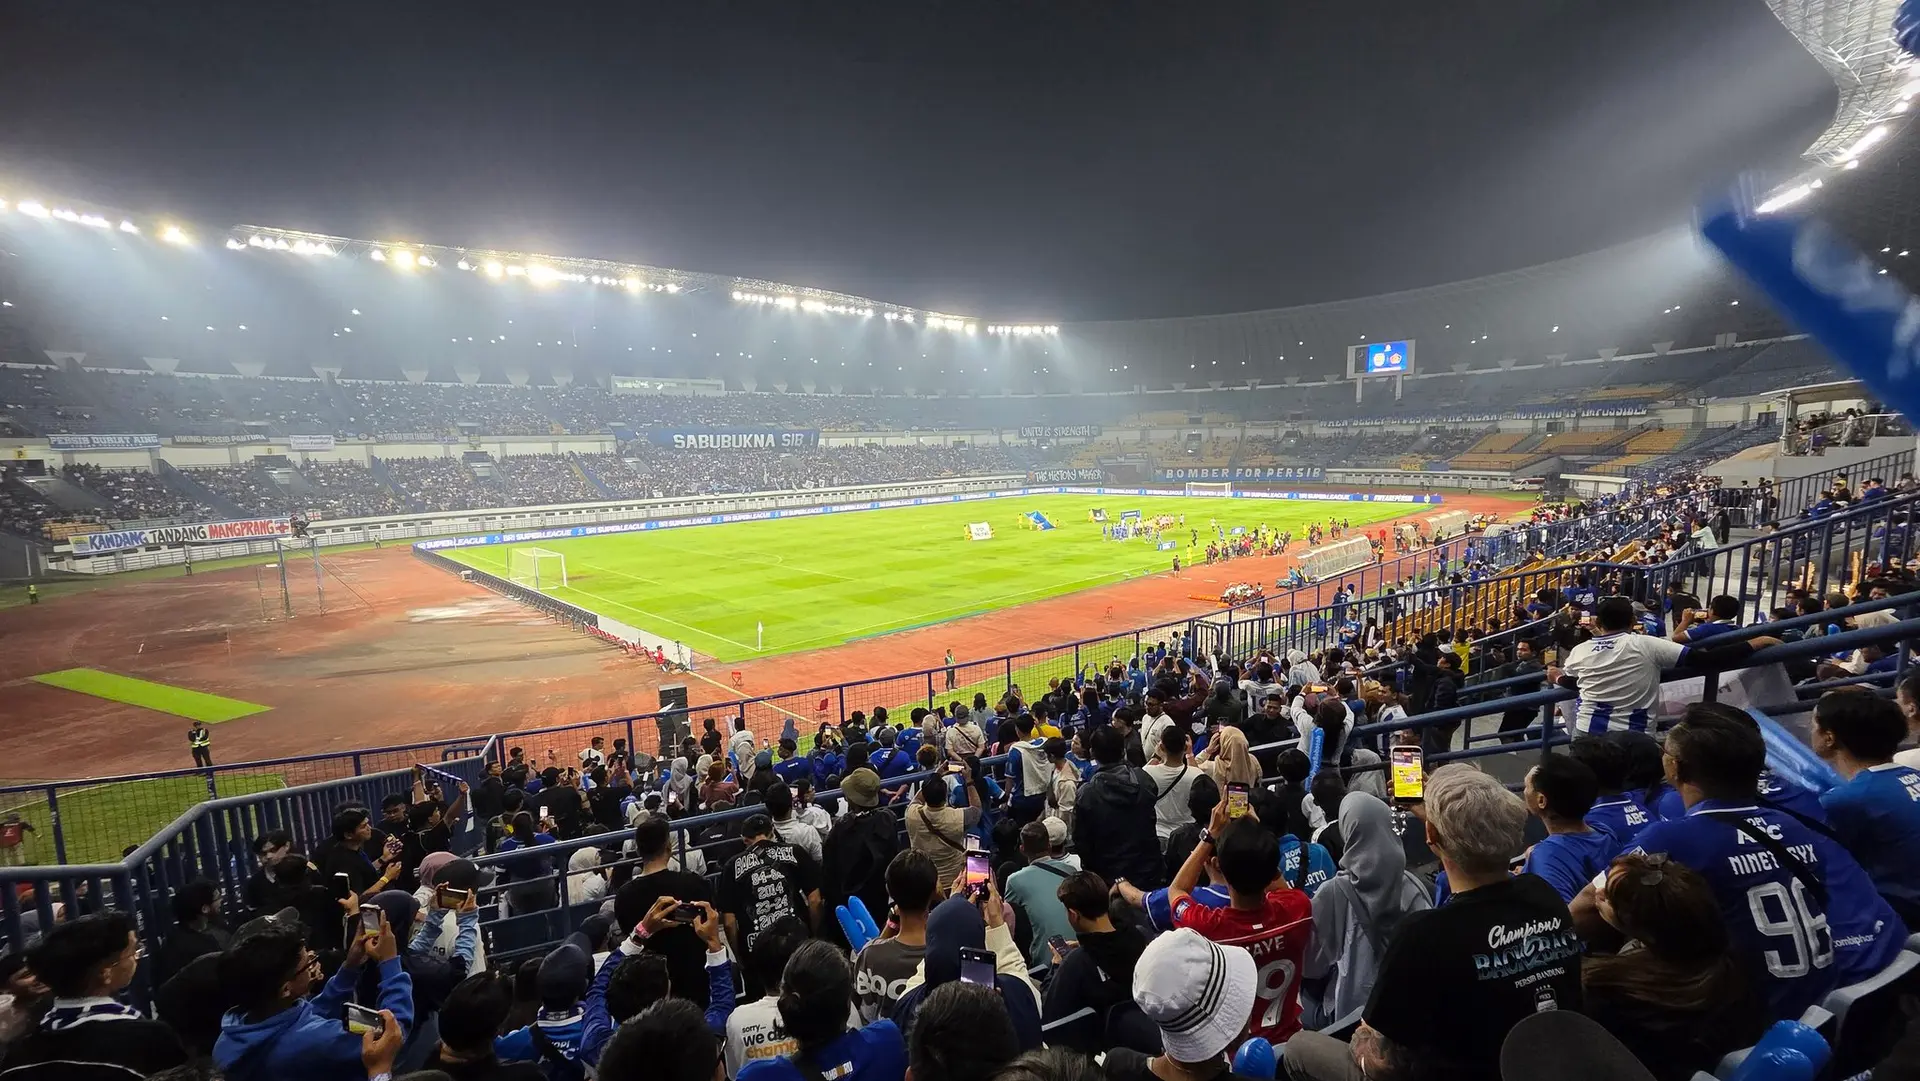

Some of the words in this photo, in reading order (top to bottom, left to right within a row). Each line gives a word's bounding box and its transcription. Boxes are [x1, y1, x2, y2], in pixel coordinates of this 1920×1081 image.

[1054, 425, 1090, 437] STRENGTH
[673, 433, 776, 449] SABUBUKNA
[781, 433, 804, 447] SIB
[1165, 468, 1230, 479] BOMBER
[1235, 468, 1261, 478] FOR
[1266, 467, 1322, 478] PERSIB
[88, 531, 148, 550] KANDANG
[149, 525, 207, 544] TANDANG
[208, 519, 275, 539] MANGPRANG
[1625, 811, 1649, 826] ABC
[1745, 817, 1768, 827] OPI
[1736, 824, 1784, 845] AC
[757, 881, 785, 900] 2014
[755, 894, 788, 915] 23-24
[1488, 917, 1562, 949] Champions
[1514, 975, 1537, 989] PERSIB
[1536, 966, 1565, 981] BANDUNG
[743, 1032, 765, 1047] we
